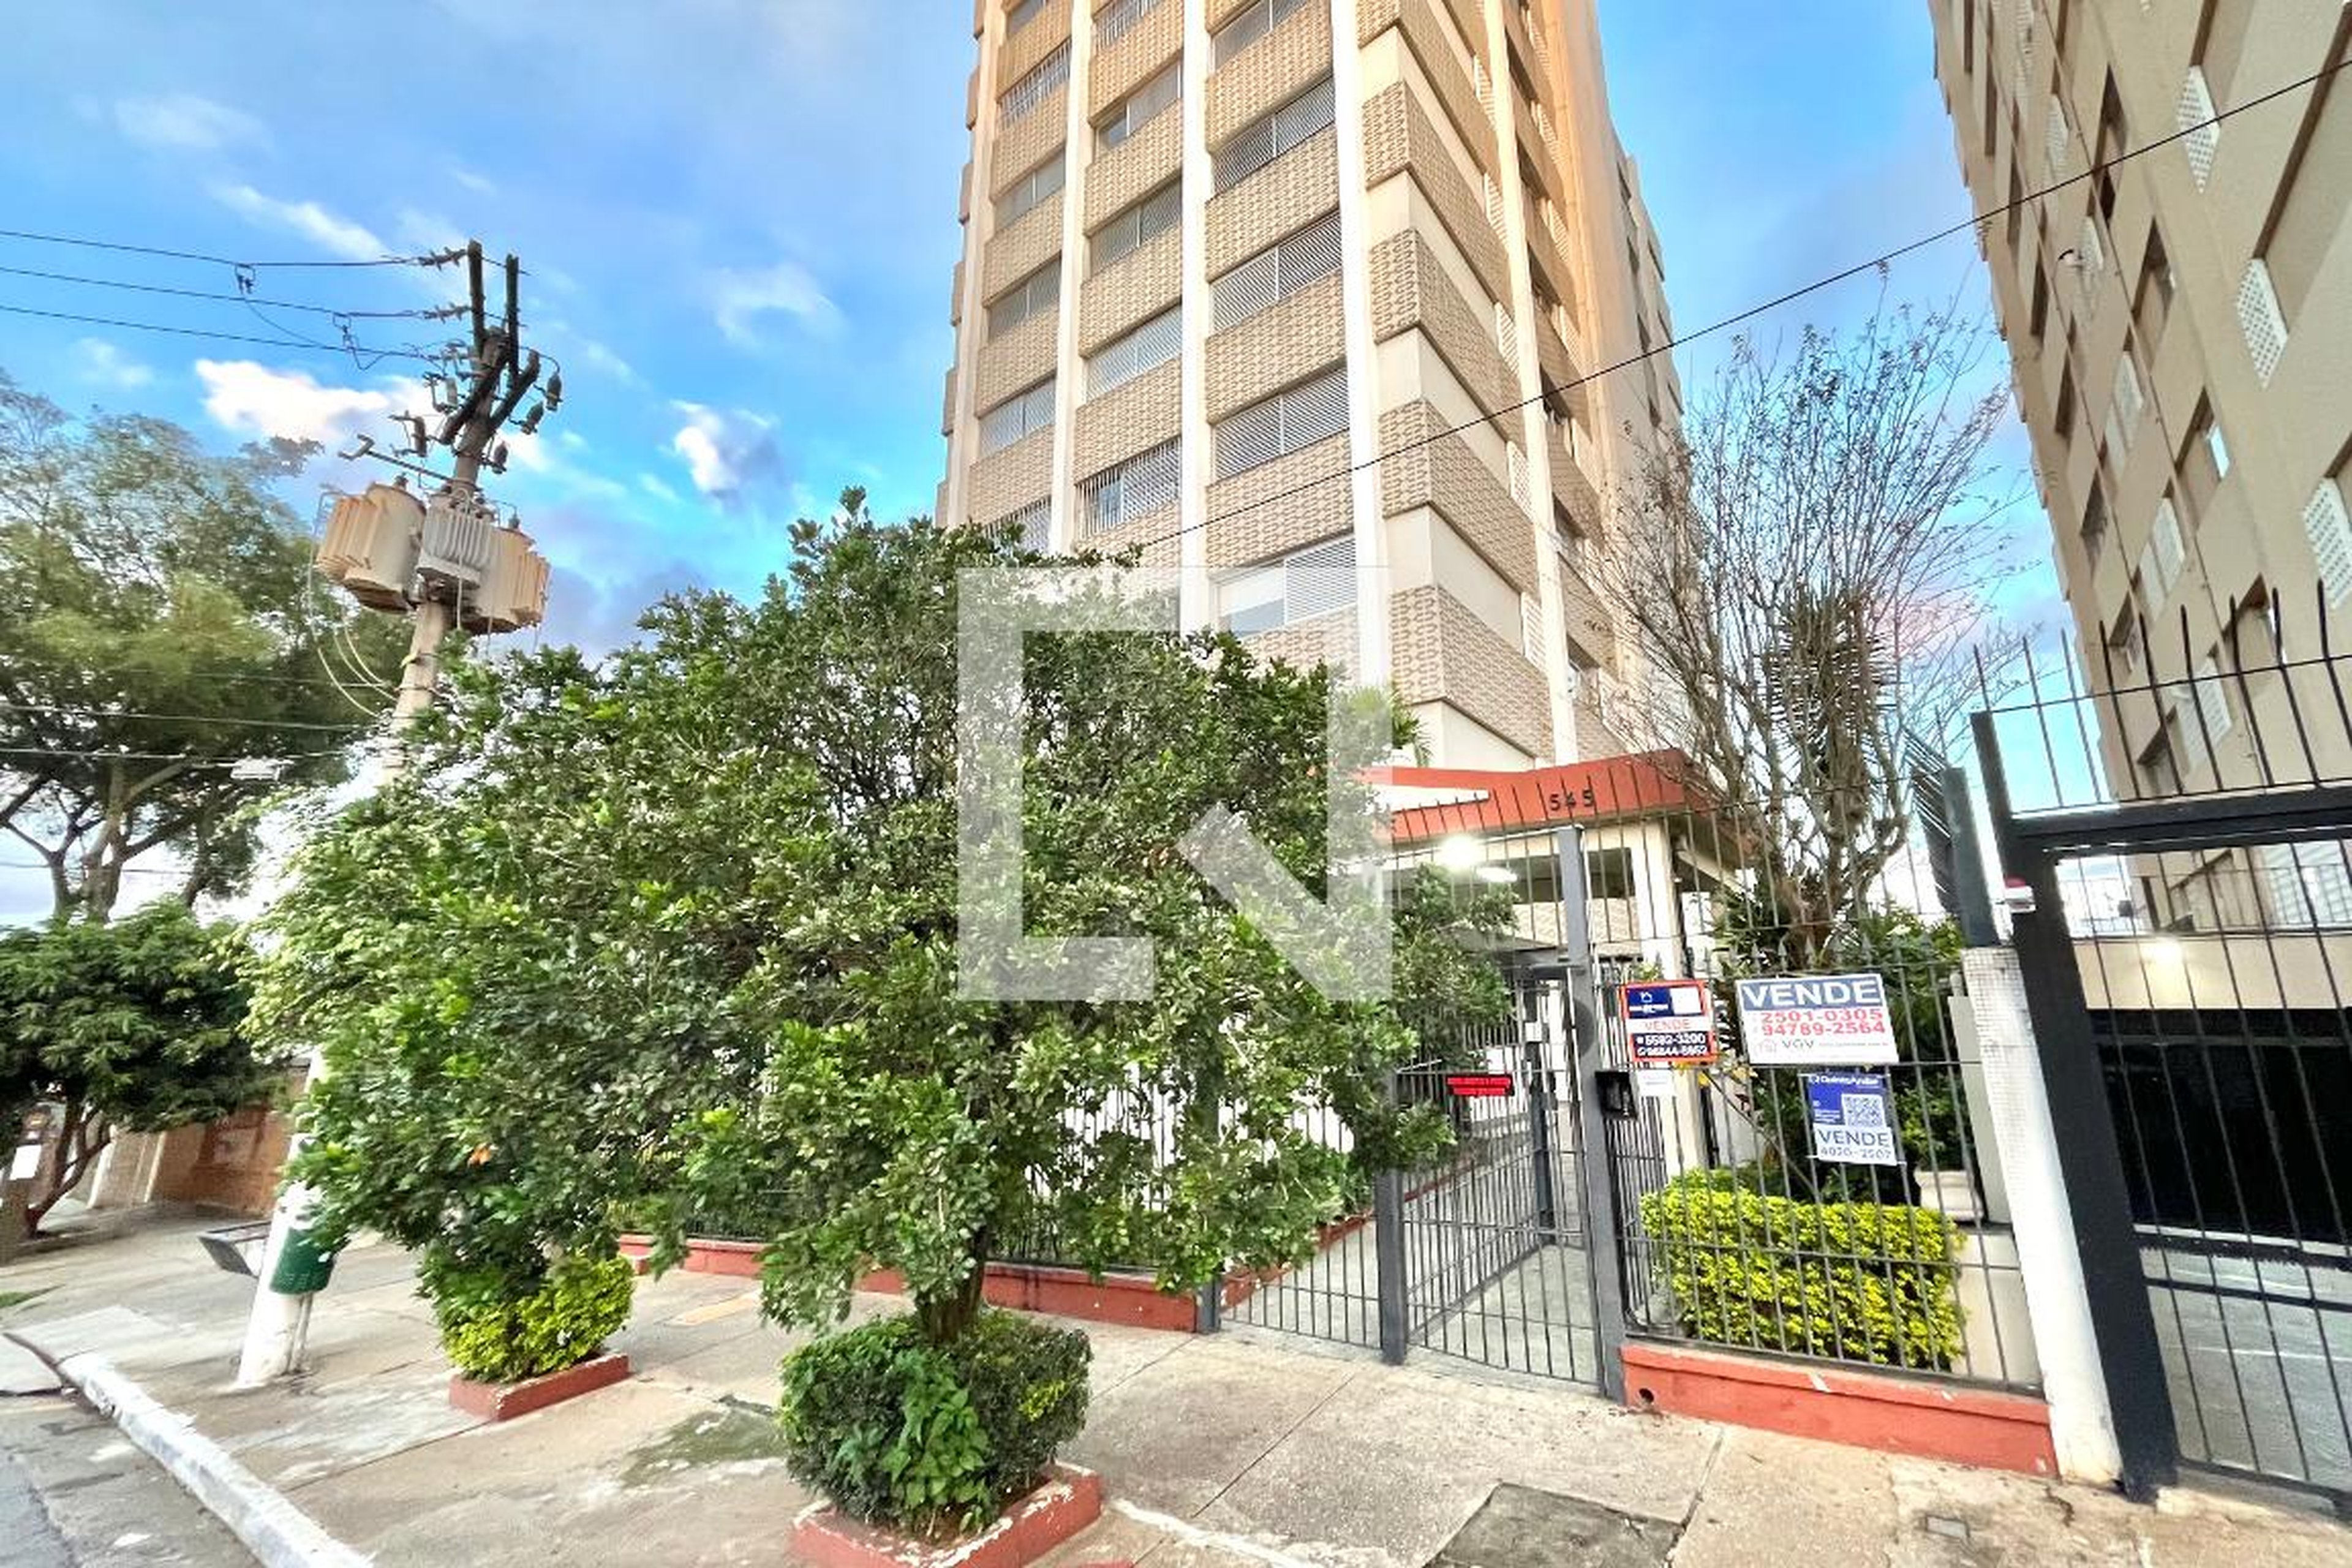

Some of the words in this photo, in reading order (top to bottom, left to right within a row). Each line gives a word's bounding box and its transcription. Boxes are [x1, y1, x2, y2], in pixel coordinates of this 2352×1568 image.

[1550, 790, 1594, 811] 545
[1743, 981, 1880, 1007] VENDE
[1761, 1008, 1883, 1023] 2501-0305
[1645, 1019, 1691, 1031] VENDE
[1817, 1128, 1889, 1146] VENDE
